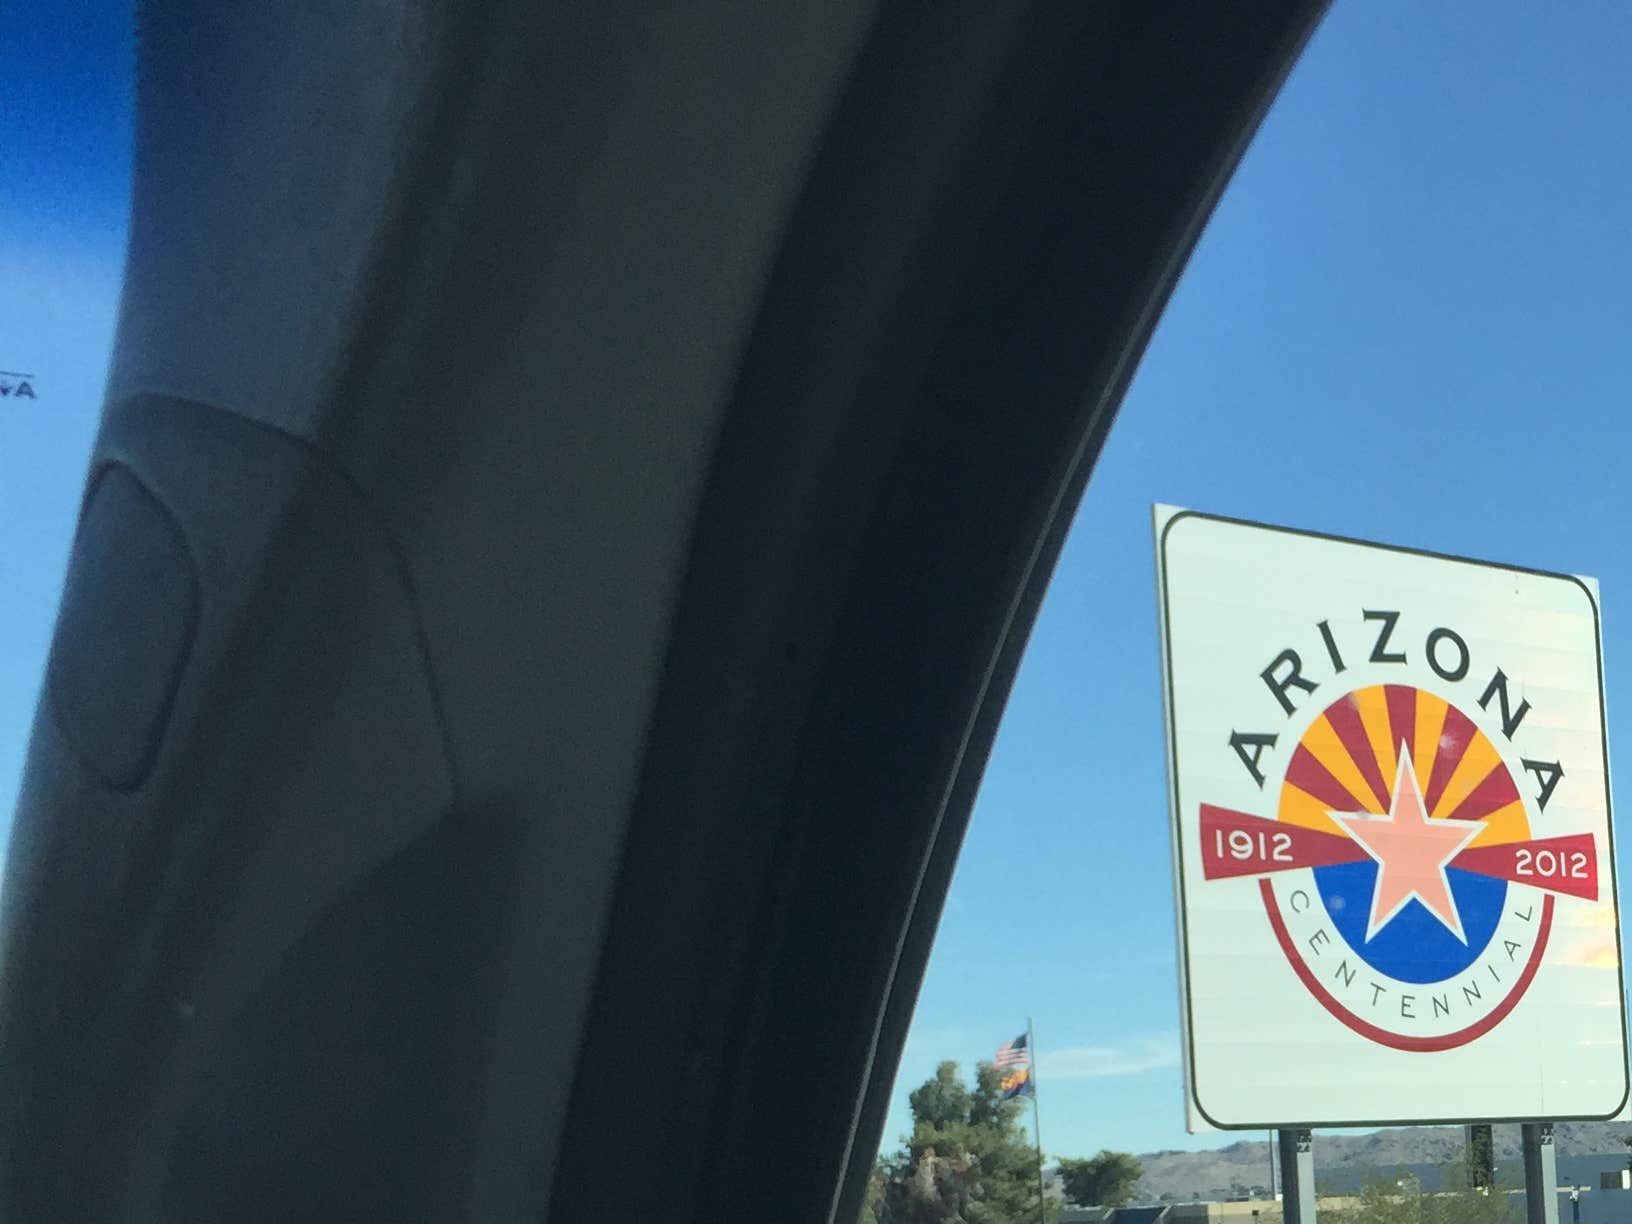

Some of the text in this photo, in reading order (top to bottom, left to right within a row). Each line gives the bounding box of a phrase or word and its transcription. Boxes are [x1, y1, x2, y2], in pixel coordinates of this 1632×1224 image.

[1229, 607, 1565, 814] ARIZONA
[1215, 828, 1294, 862] 1912
[1515, 848, 1589, 879] 2012
[1290, 889, 1533, 1018] CENTENNIAL
